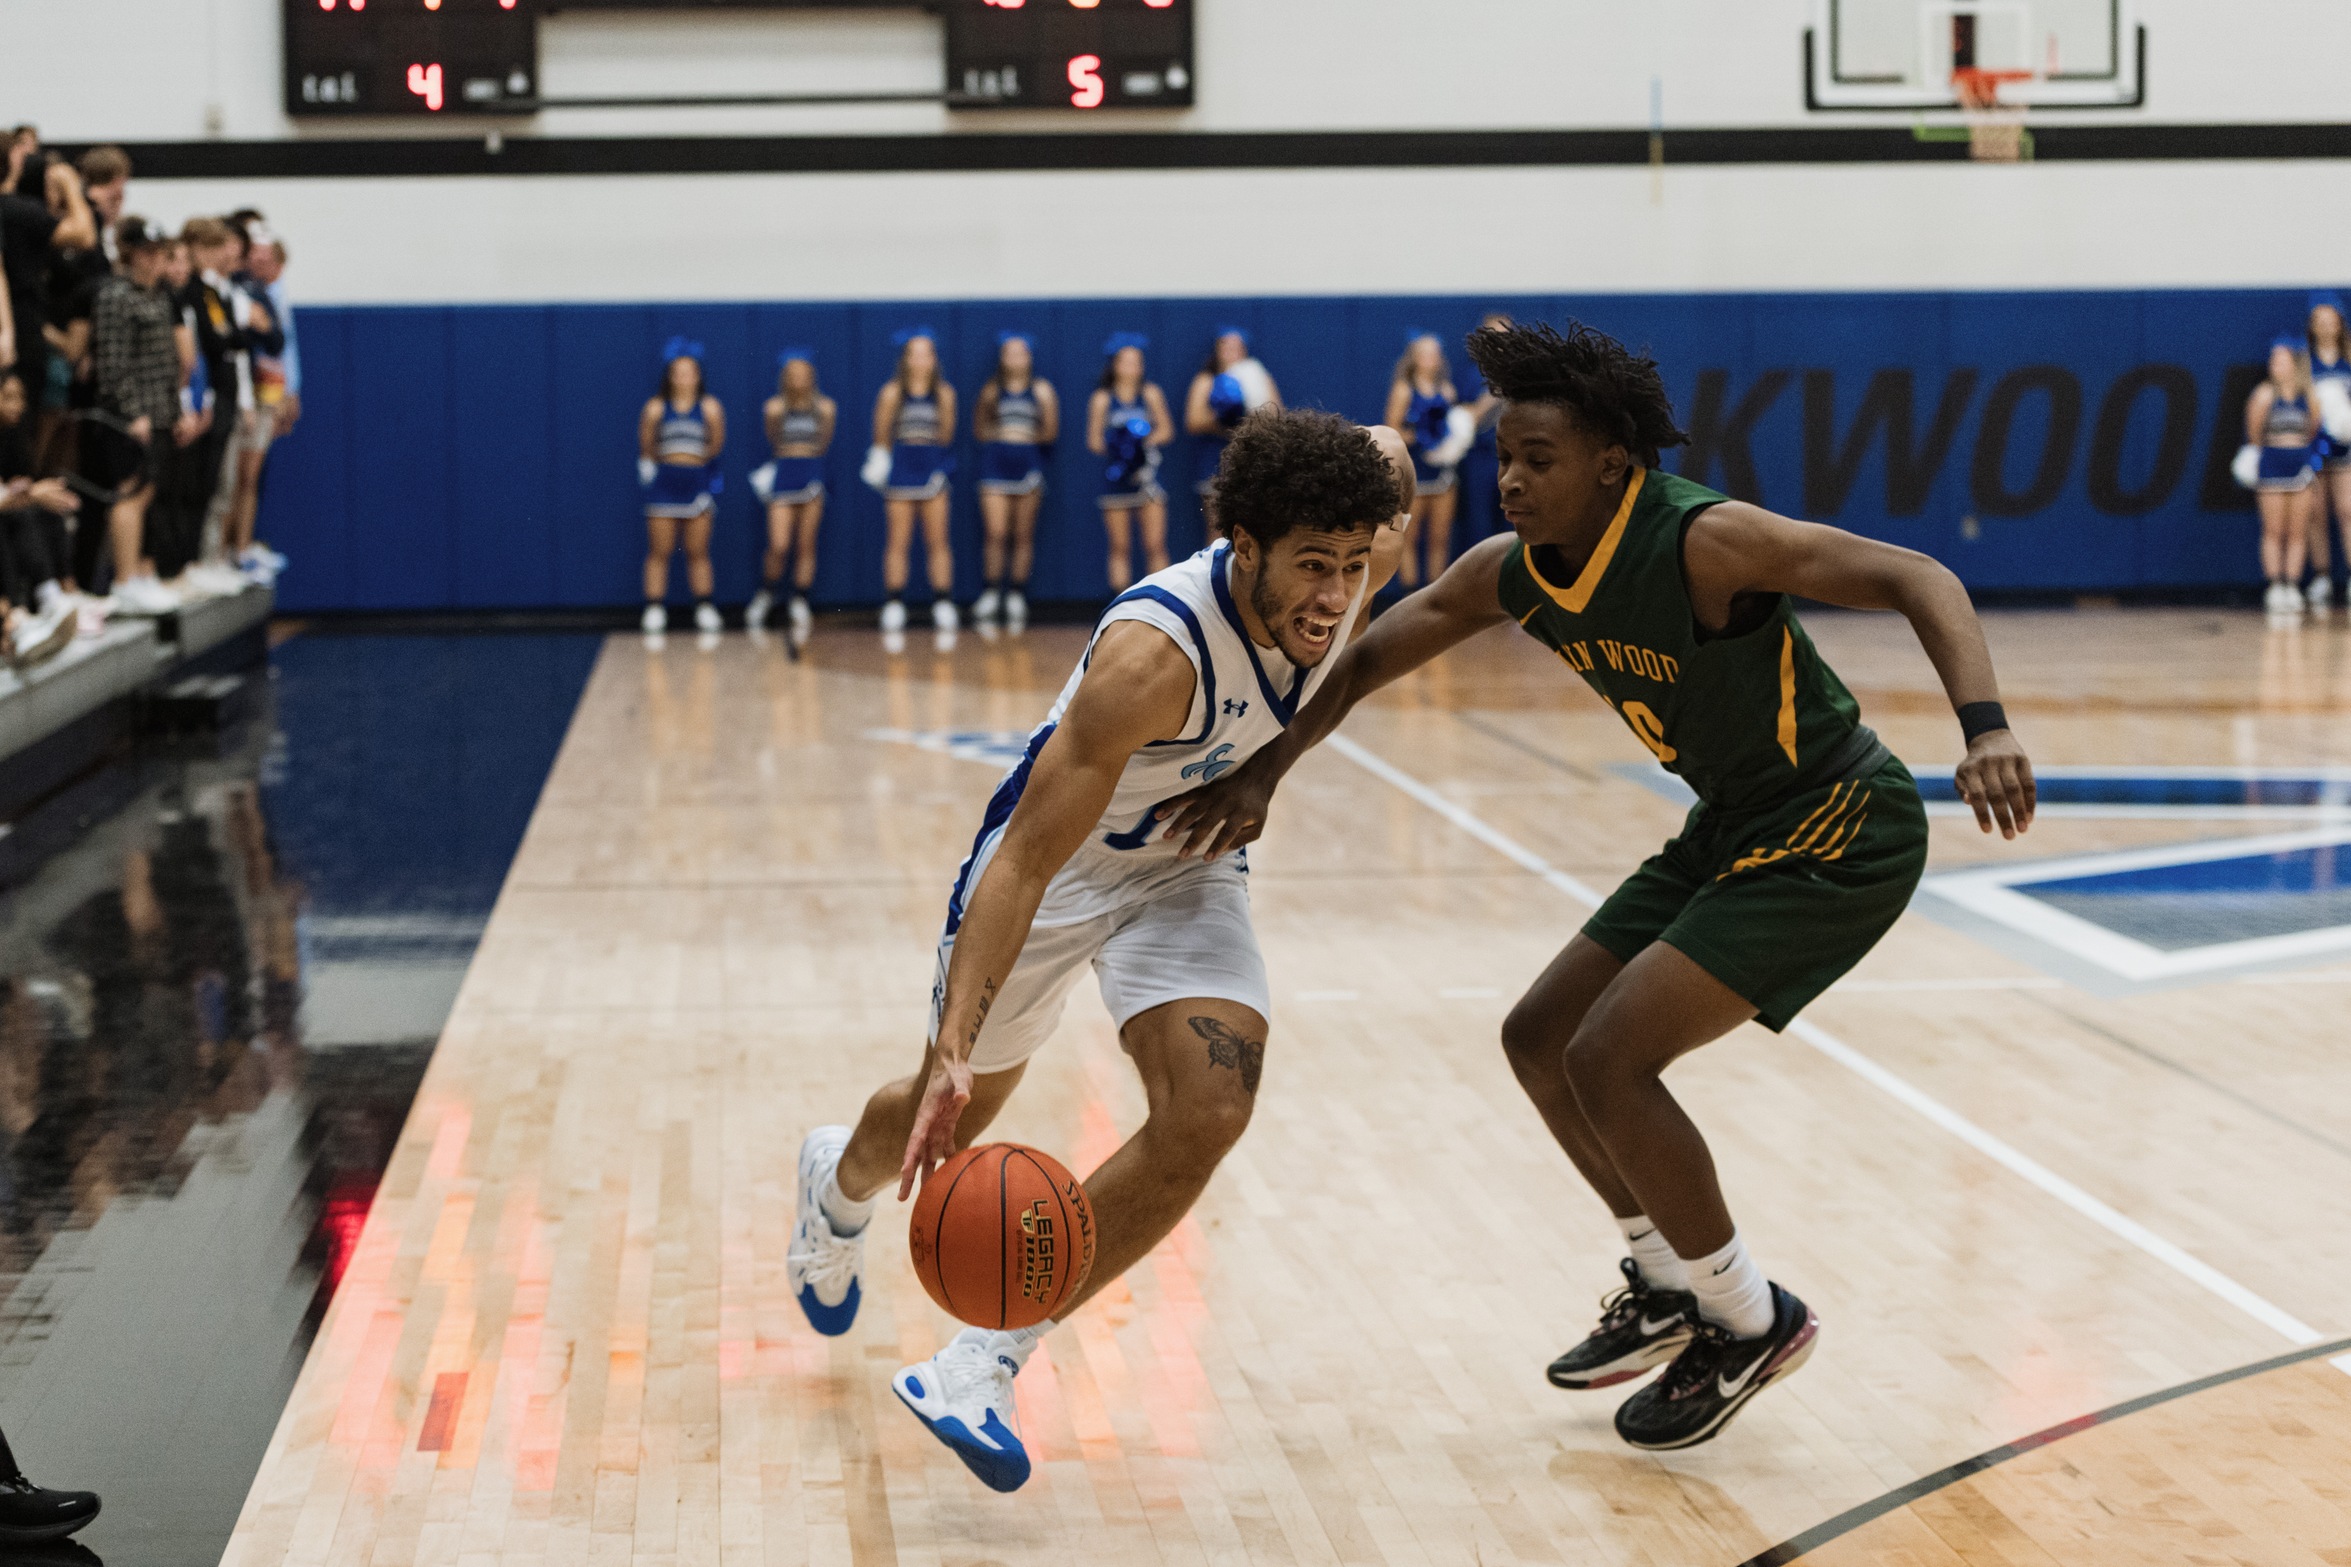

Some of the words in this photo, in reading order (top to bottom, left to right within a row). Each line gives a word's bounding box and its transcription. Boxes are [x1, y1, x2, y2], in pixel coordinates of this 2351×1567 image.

[407, 63, 443, 111] 4
[1067, 54, 1104, 108] 5
[1597, 639, 1679, 684] WOOD
[1022, 1235, 1036, 1298] 1000
[1032, 1199, 1055, 1304] LEGACY
